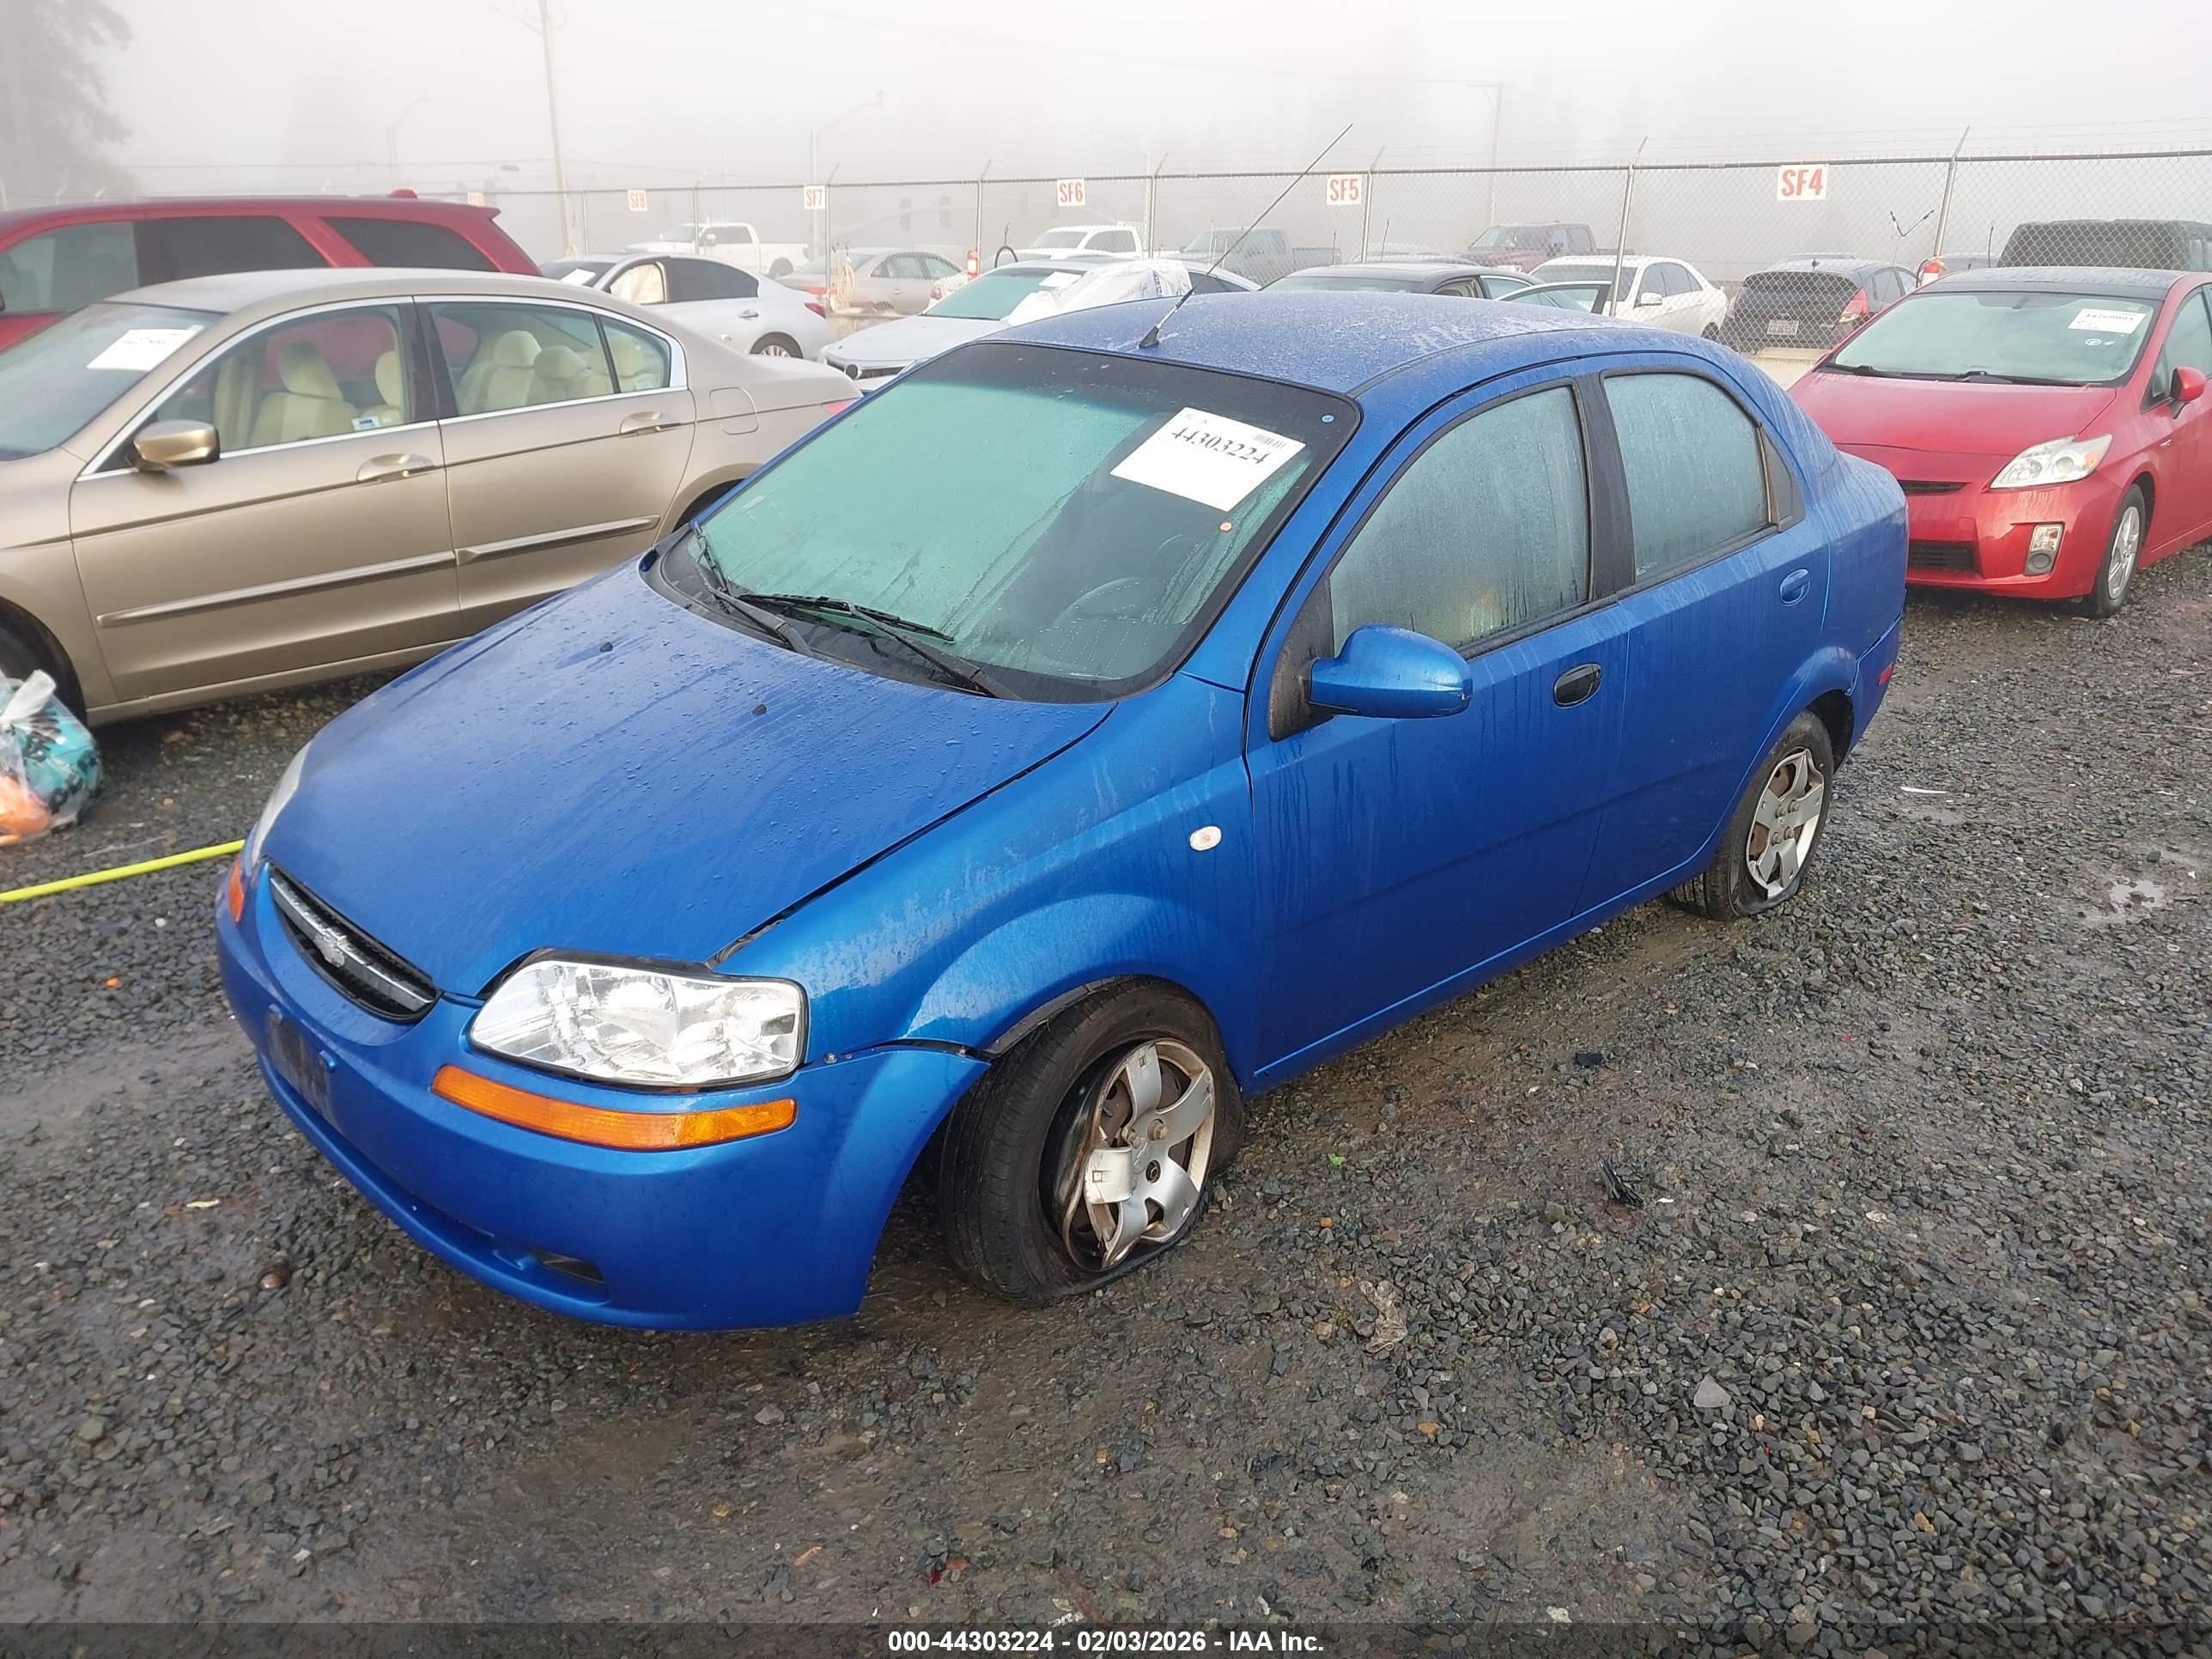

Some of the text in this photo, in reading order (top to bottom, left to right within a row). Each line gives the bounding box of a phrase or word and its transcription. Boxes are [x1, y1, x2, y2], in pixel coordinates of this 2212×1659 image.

[1059, 182, 1083, 203] SF6
[1329, 179, 1358, 201] SF5
[1781, 168, 1823, 197] SF4
[806, 189, 823, 206] SF7
[1171, 427, 1271, 465] 44303224
